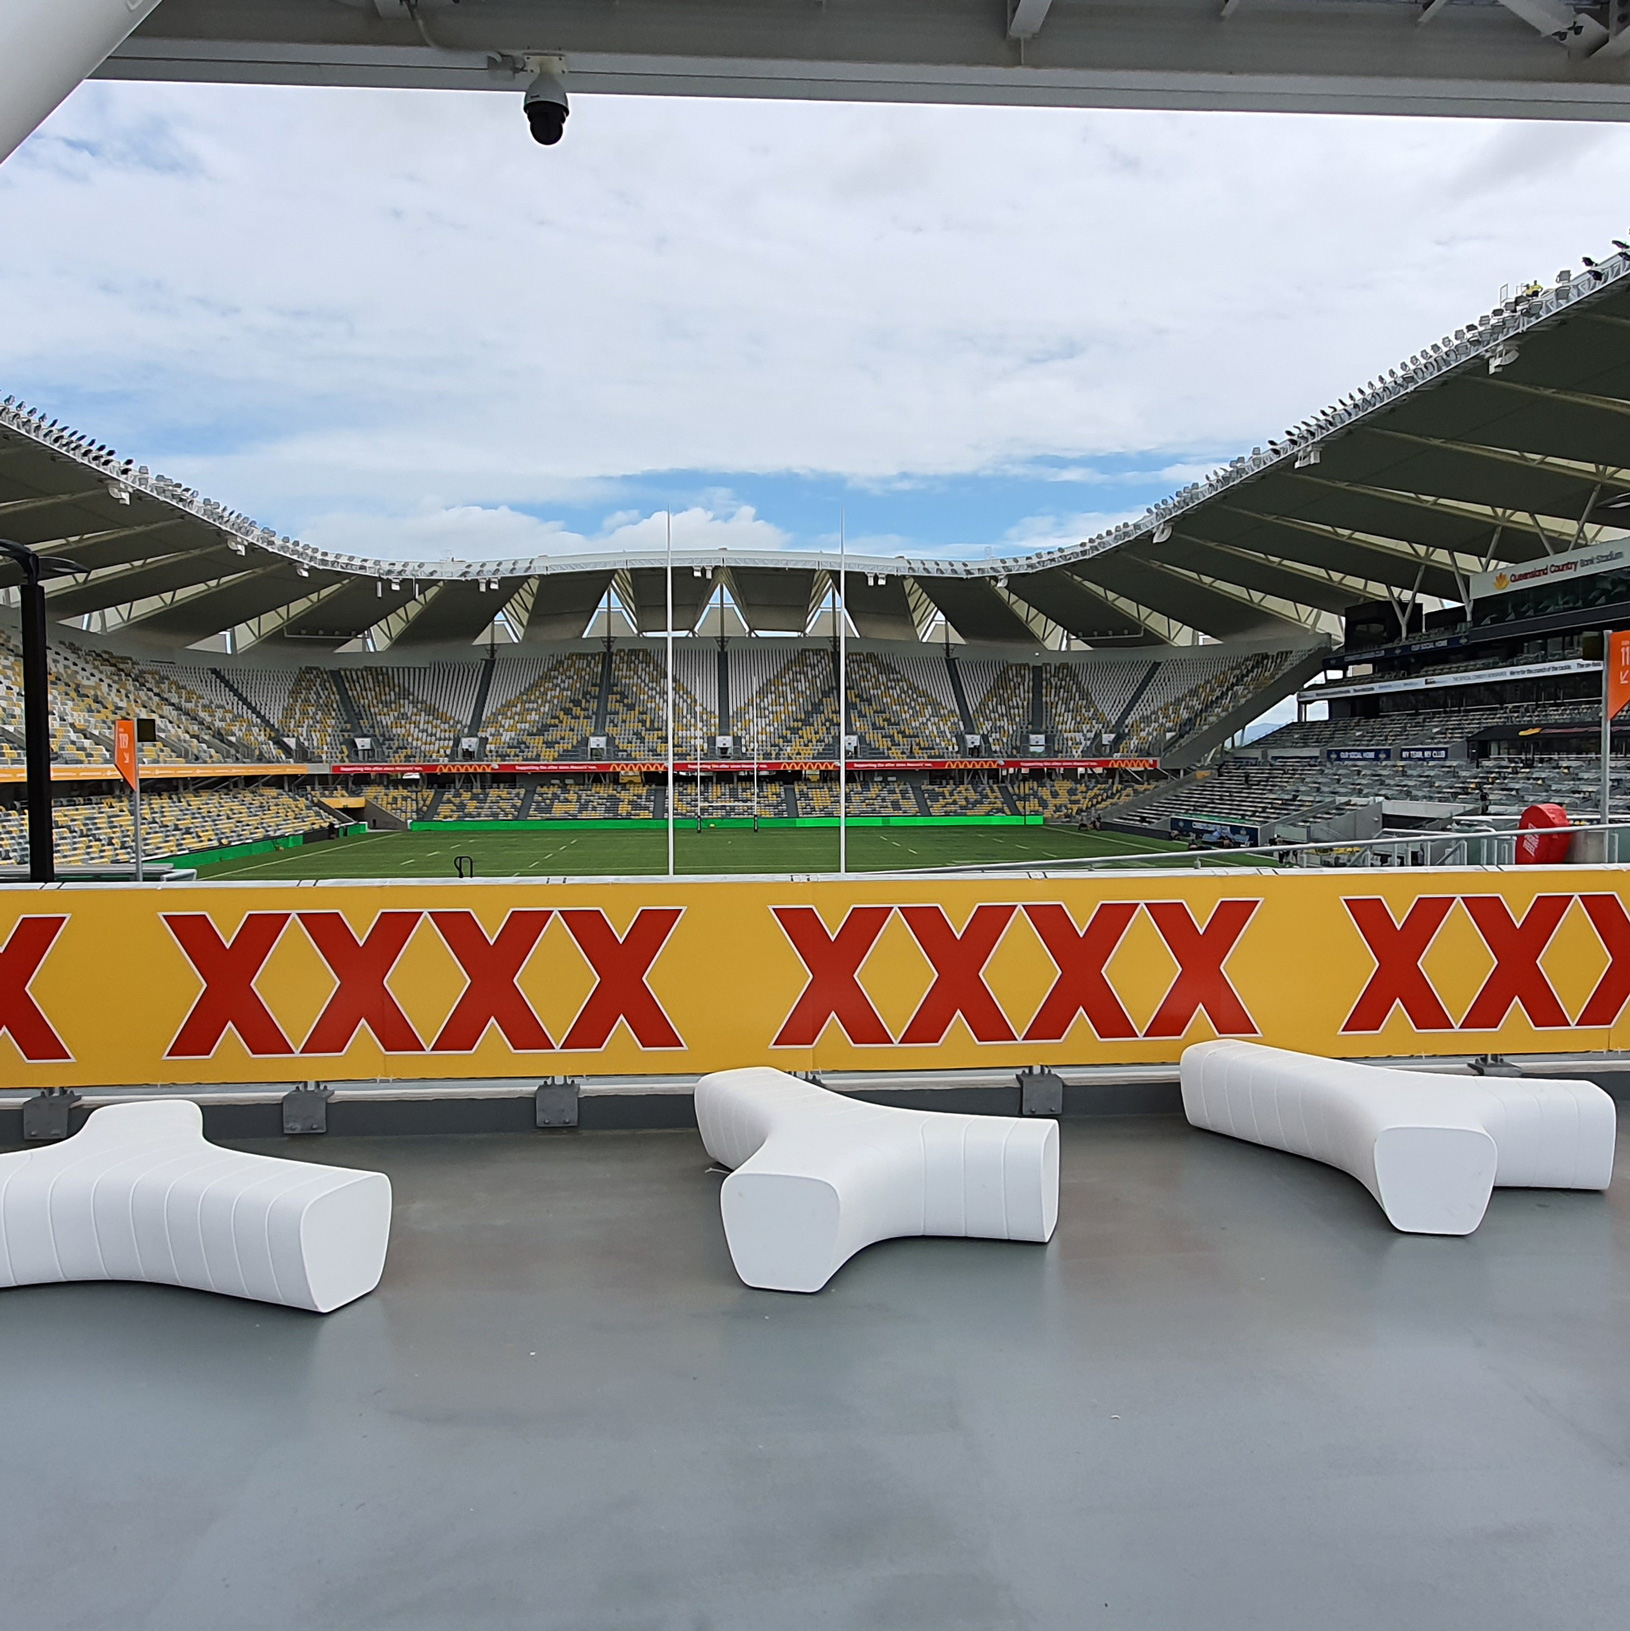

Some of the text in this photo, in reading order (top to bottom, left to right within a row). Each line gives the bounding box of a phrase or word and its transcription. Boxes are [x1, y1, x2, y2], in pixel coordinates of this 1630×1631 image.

[1510, 550, 1623, 582] Queensland Country Bank Stadium
[157, 906, 689, 1060] XXXX
[768, 897, 1264, 1048] XXXX
